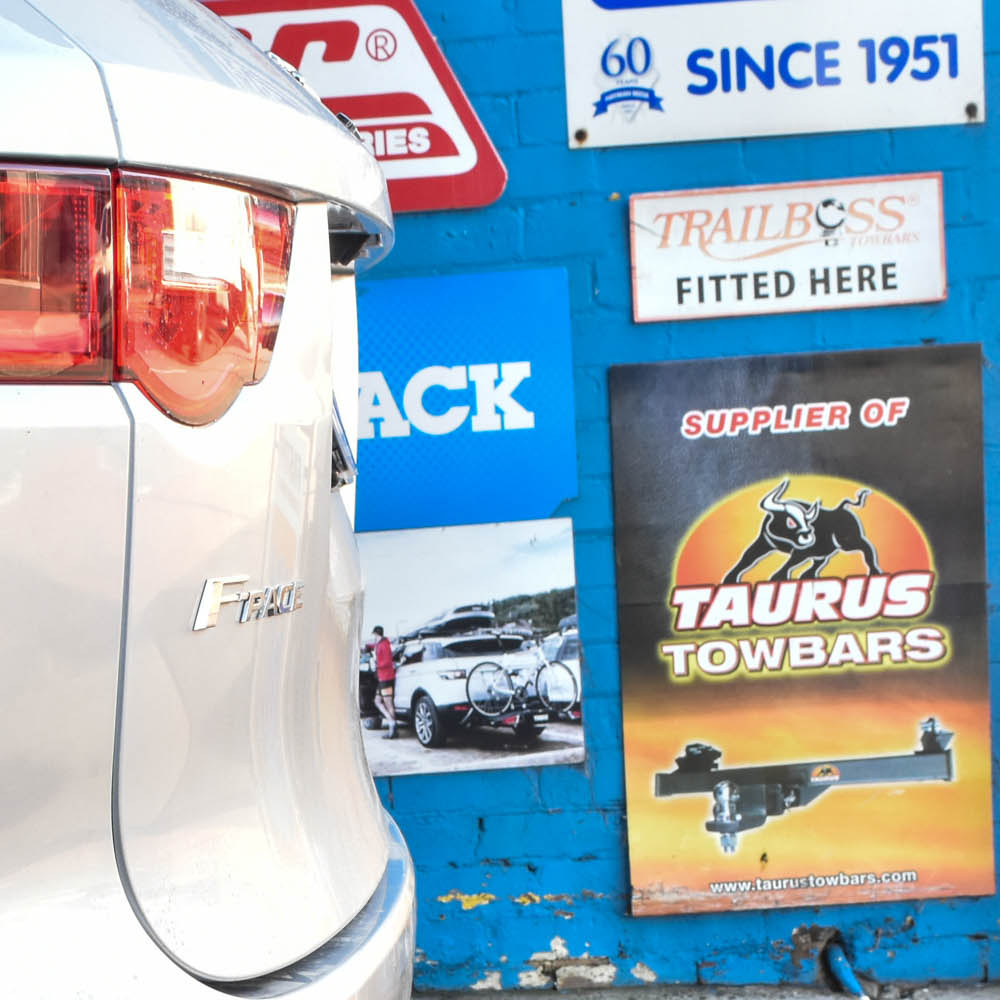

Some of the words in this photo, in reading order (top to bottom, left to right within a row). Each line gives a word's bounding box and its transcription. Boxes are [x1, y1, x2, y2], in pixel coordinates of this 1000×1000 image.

[601, 36, 651, 77] 60
[686, 41, 842, 95] SINCE
[858, 34, 958, 84] 1951
[677, 270, 795, 304] FITTED
[810, 263, 898, 295] HERE
[358, 361, 535, 440] ACK
[682, 401, 851, 438] SUPPLIER
[860, 397, 909, 427] OF
[671, 571, 934, 631] TAURUS
[660, 628, 946, 677] TOWBARS
[710, 870, 917, 893] www.taurustowbars.com
